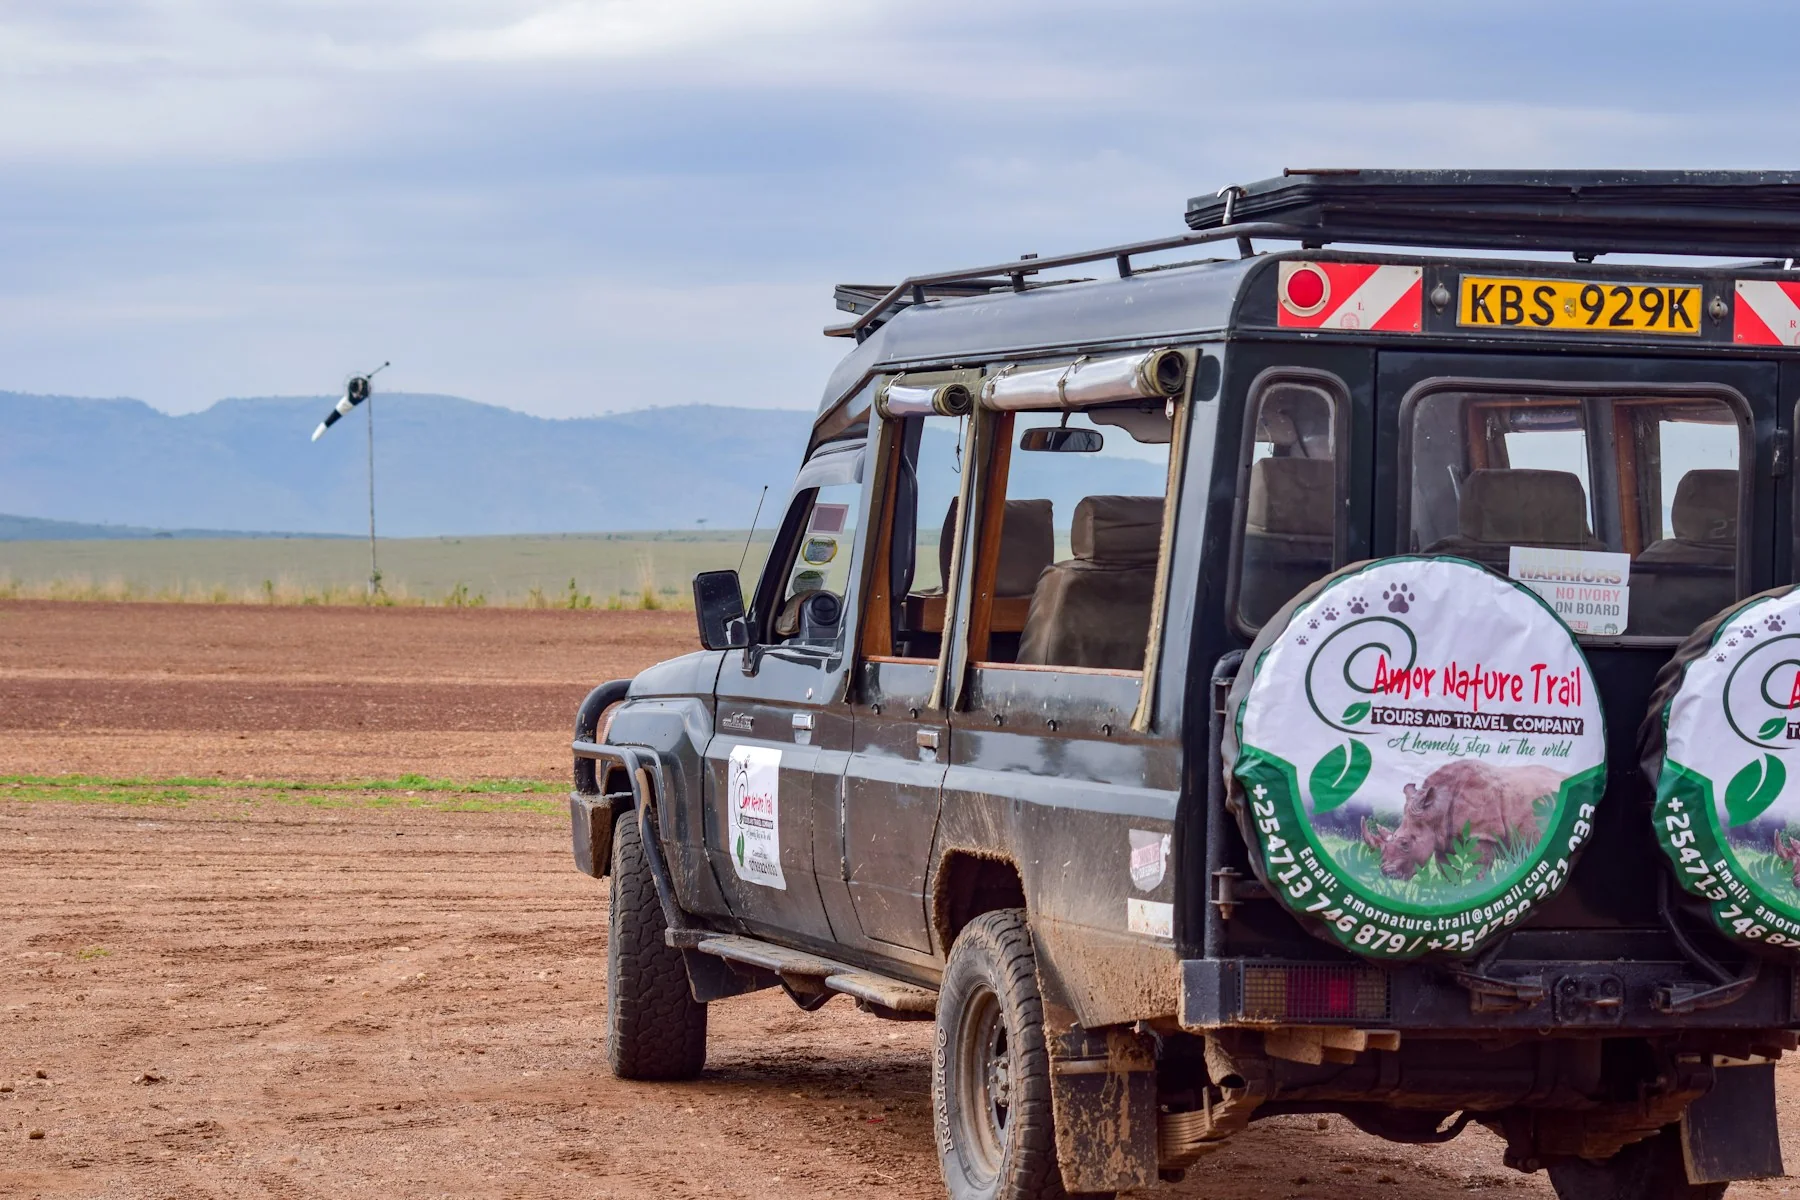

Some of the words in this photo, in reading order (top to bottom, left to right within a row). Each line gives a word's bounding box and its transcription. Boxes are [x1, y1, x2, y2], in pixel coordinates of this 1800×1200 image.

[1471, 284, 1557, 326] KBS
[1580, 284, 1694, 328] 929K
[1790, 319, 1797, 328] R
[1555, 601, 1573, 614] ON
[1576, 602, 1620, 617] BOARD
[1556, 587, 1575, 600] NO
[1580, 588, 1621, 603] IVORY
[1372, 654, 1436, 700] Amor
[1443, 661, 1523, 712] Nature
[1530, 663, 1581, 707] Trail
[1374, 708, 1423, 725] TOURS
[1426, 712, 1451, 727] AND
[1453, 713, 1508, 730] TRAVEL
[1513, 717, 1582, 734] COMPANY
[1411, 732, 1464, 757] homely
[1463, 736, 1491, 757] step
[1498, 738, 1511, 755] in
[1509, 738, 1536, 756] the
[1541, 740, 1573, 758] wild
[1253, 783, 1313, 898] +254713
[1305, 892, 1358, 932] 746
[1354, 923, 1406, 953] 879
[1534, 858, 1569, 901] 221
[1299, 846, 1338, 893] Email:
[1343, 860, 1550, 931] amornature.trail@gmail.com
[1665, 797, 1728, 901] +254713
[1719, 903, 1768, 939] 746
[1713, 858, 1750, 904] Email:
